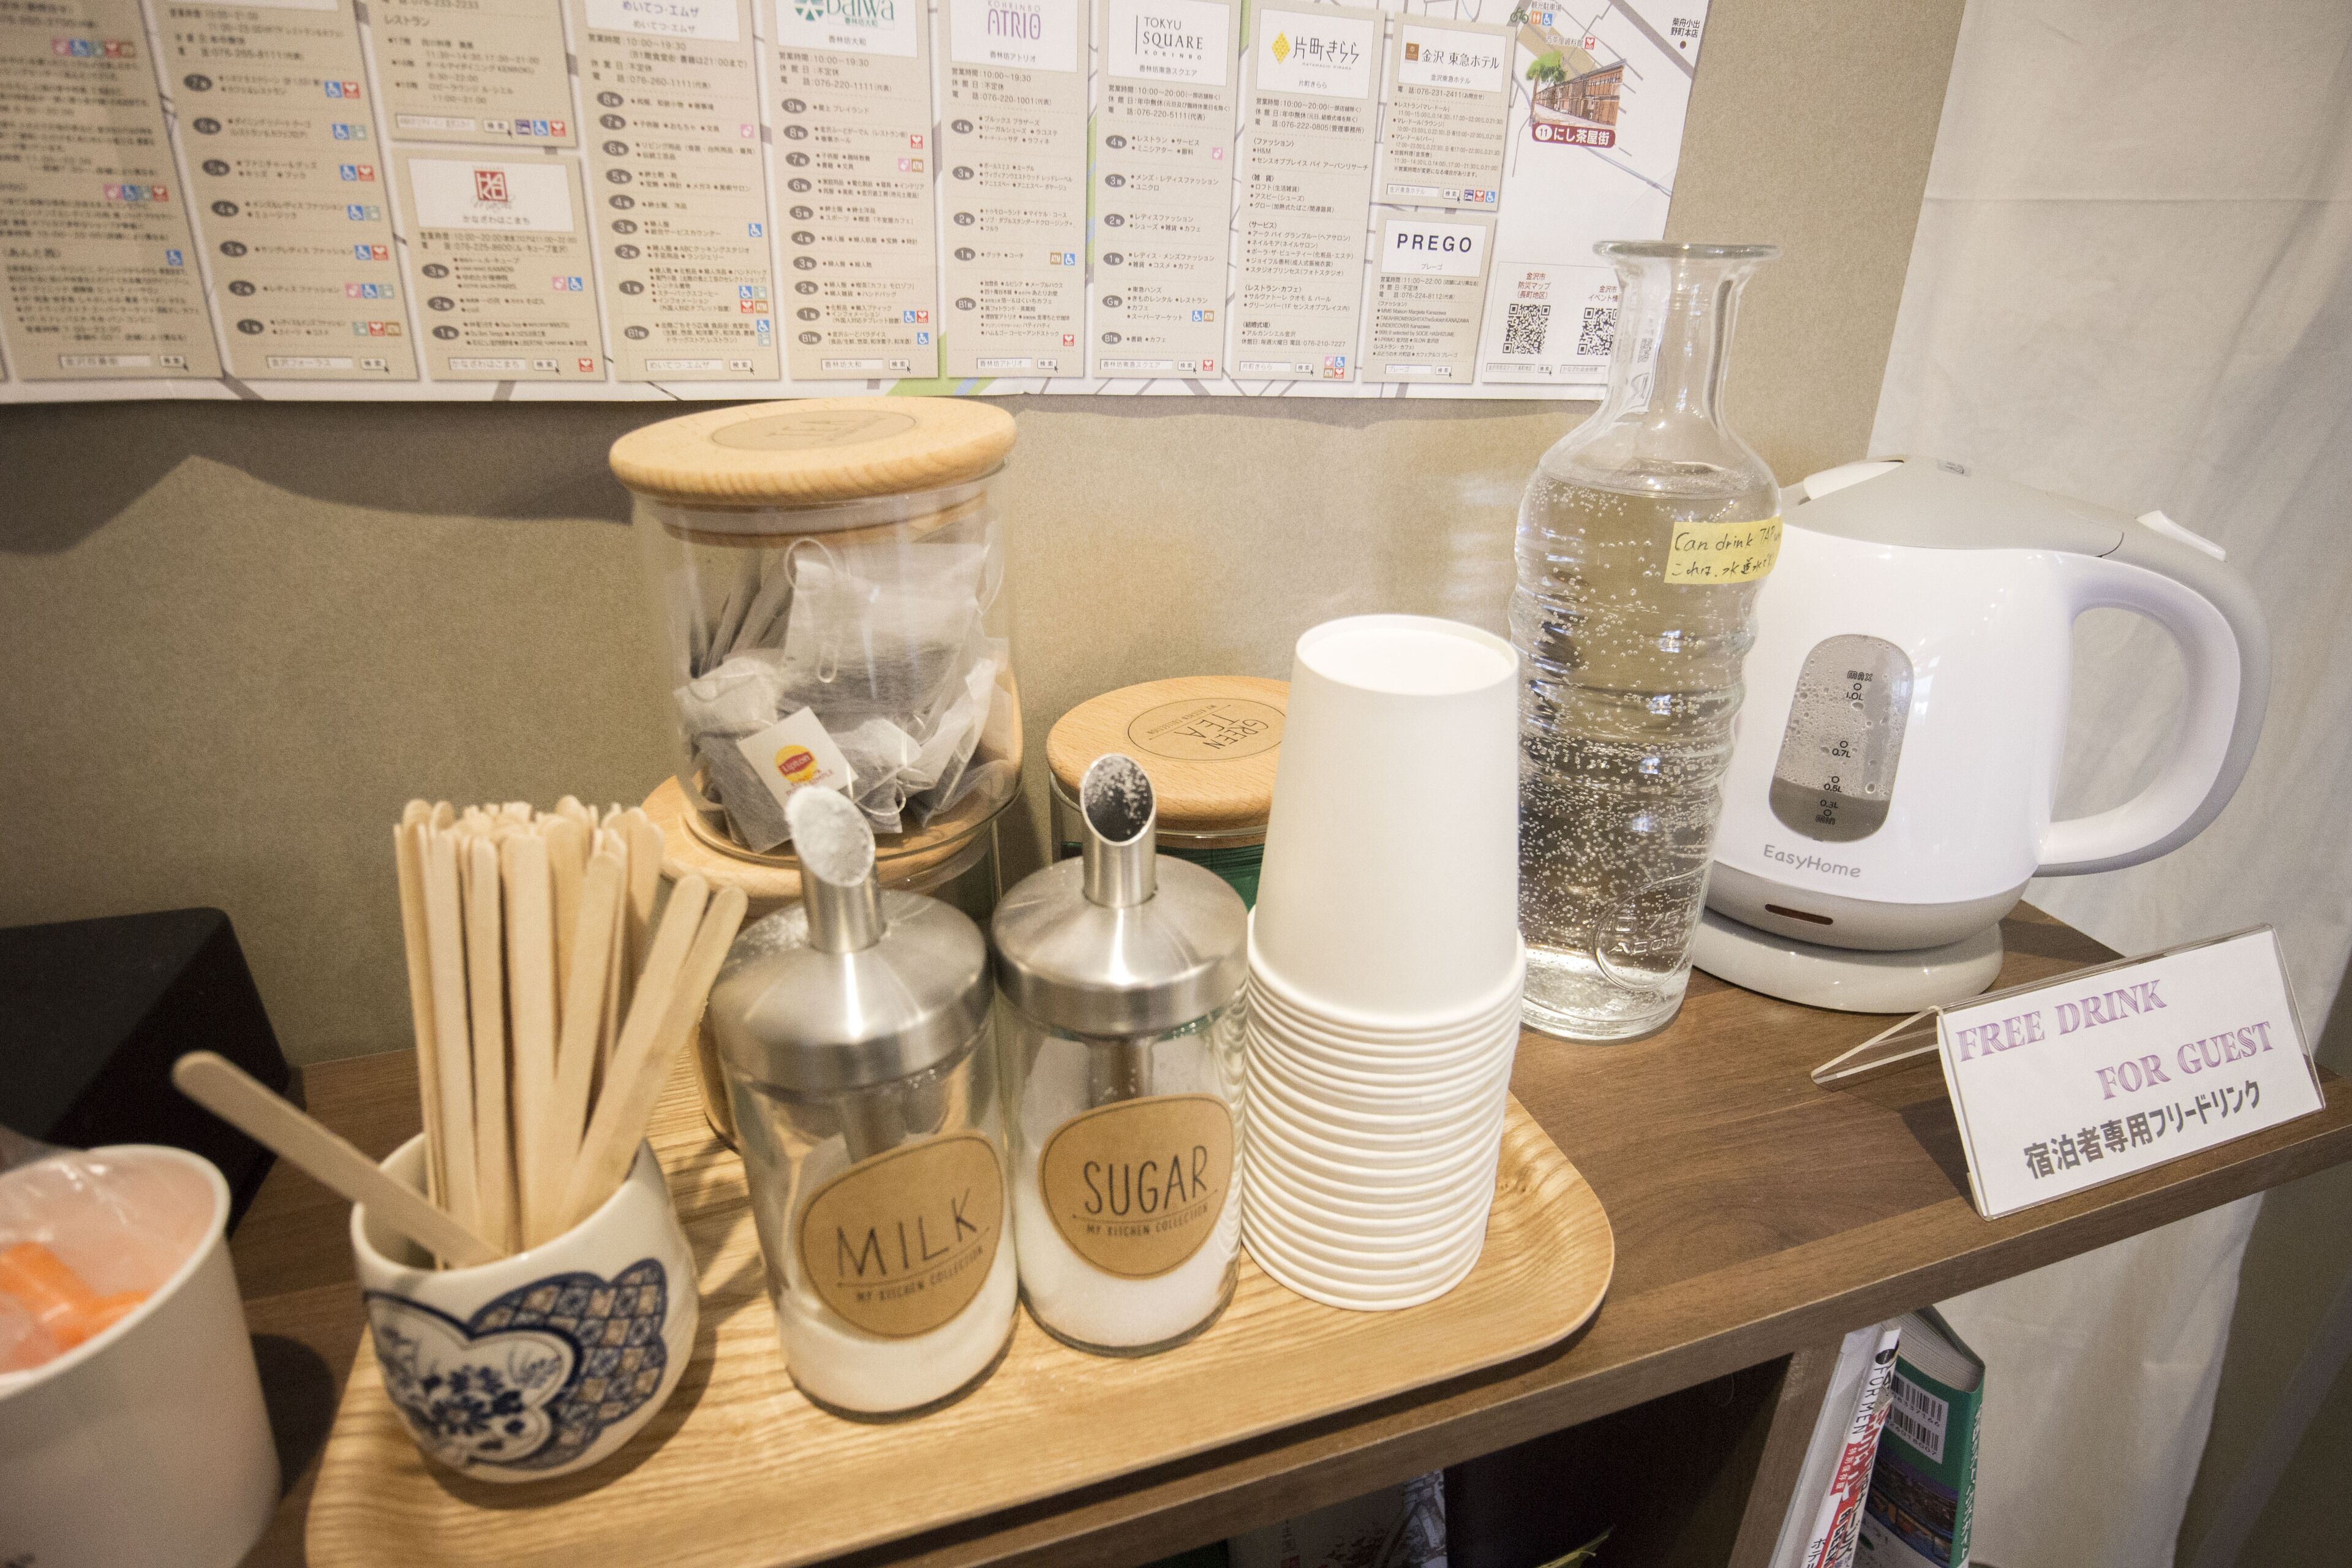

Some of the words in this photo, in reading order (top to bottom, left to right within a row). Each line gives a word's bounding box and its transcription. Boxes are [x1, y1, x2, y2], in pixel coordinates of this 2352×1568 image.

[987, 9, 1041, 40] ATRIO
[1144, 17, 1182, 30] TOKYU
[1142, 31, 1203, 50] SQUARE
[1293, 36, 1360, 65] 片町きらら
[1422, 48, 1444, 64] 金沢
[1449, 51, 1500, 69] 東急ホテル
[1431, 74, 1471, 84] 金沢東急ホテル
[1553, 128, 1610, 146] にし茶屋街
[1396, 233, 1472, 253] PREGO
[1518, 281, 1551, 290] 防災マップ
[1526, 272, 1546, 281] 金沢市
[1675, 532, 1709, 551] Can
[1715, 533, 1753, 551] drink
[1846, 692, 1863, 701] 1.0L
[1174, 714, 1239, 739] TEA
[1203, 718, 1268, 750] GREEN
[1832, 748, 1851, 758] 0.7L
[1823, 783, 1843, 793] 0.5L
[1820, 799, 1839, 809] 0.3L
[1763, 844, 1861, 878] EasyHome
[1956, 1011, 2045, 1062] FREE
[2054, 979, 2168, 1035] DRINK
[2095, 1054, 2171, 1101] FOR
[2177, 1021, 2274, 1075] GUEST
[2023, 1080, 2261, 1180] 宿泊者専用フリードリンク
[1083, 1145, 1208, 1216] SUGAR
[836, 1188, 978, 1277] MILK
